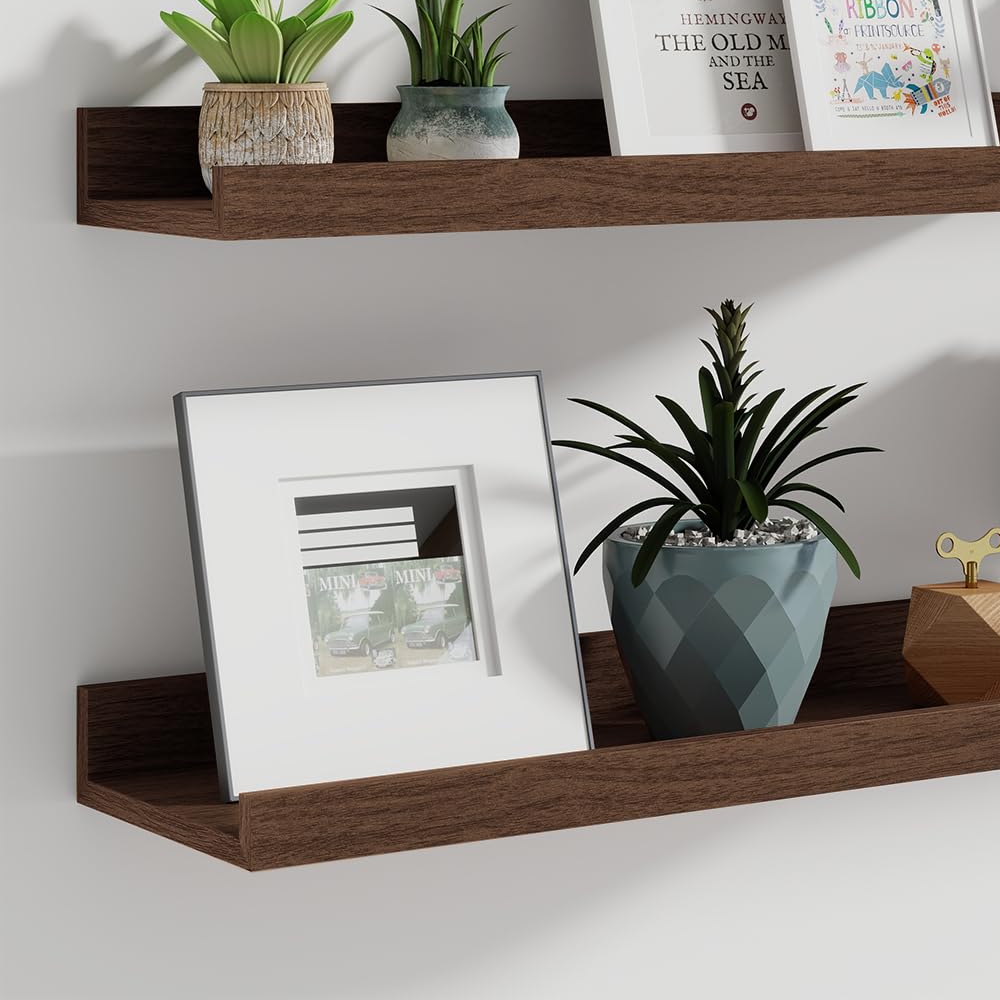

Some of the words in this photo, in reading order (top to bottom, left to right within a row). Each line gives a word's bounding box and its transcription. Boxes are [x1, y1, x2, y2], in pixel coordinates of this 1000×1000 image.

[680, 12, 787, 26] HEMINGWAY
[654, 34, 706, 52] THE
[711, 33, 761, 51] OLD
[709, 55, 741, 67] AND
[743, 55, 776, 67] THE
[722, 71, 769, 91] SEA
[319, 573, 357, 591] MINI
[395, 567, 433, 585] MINI
